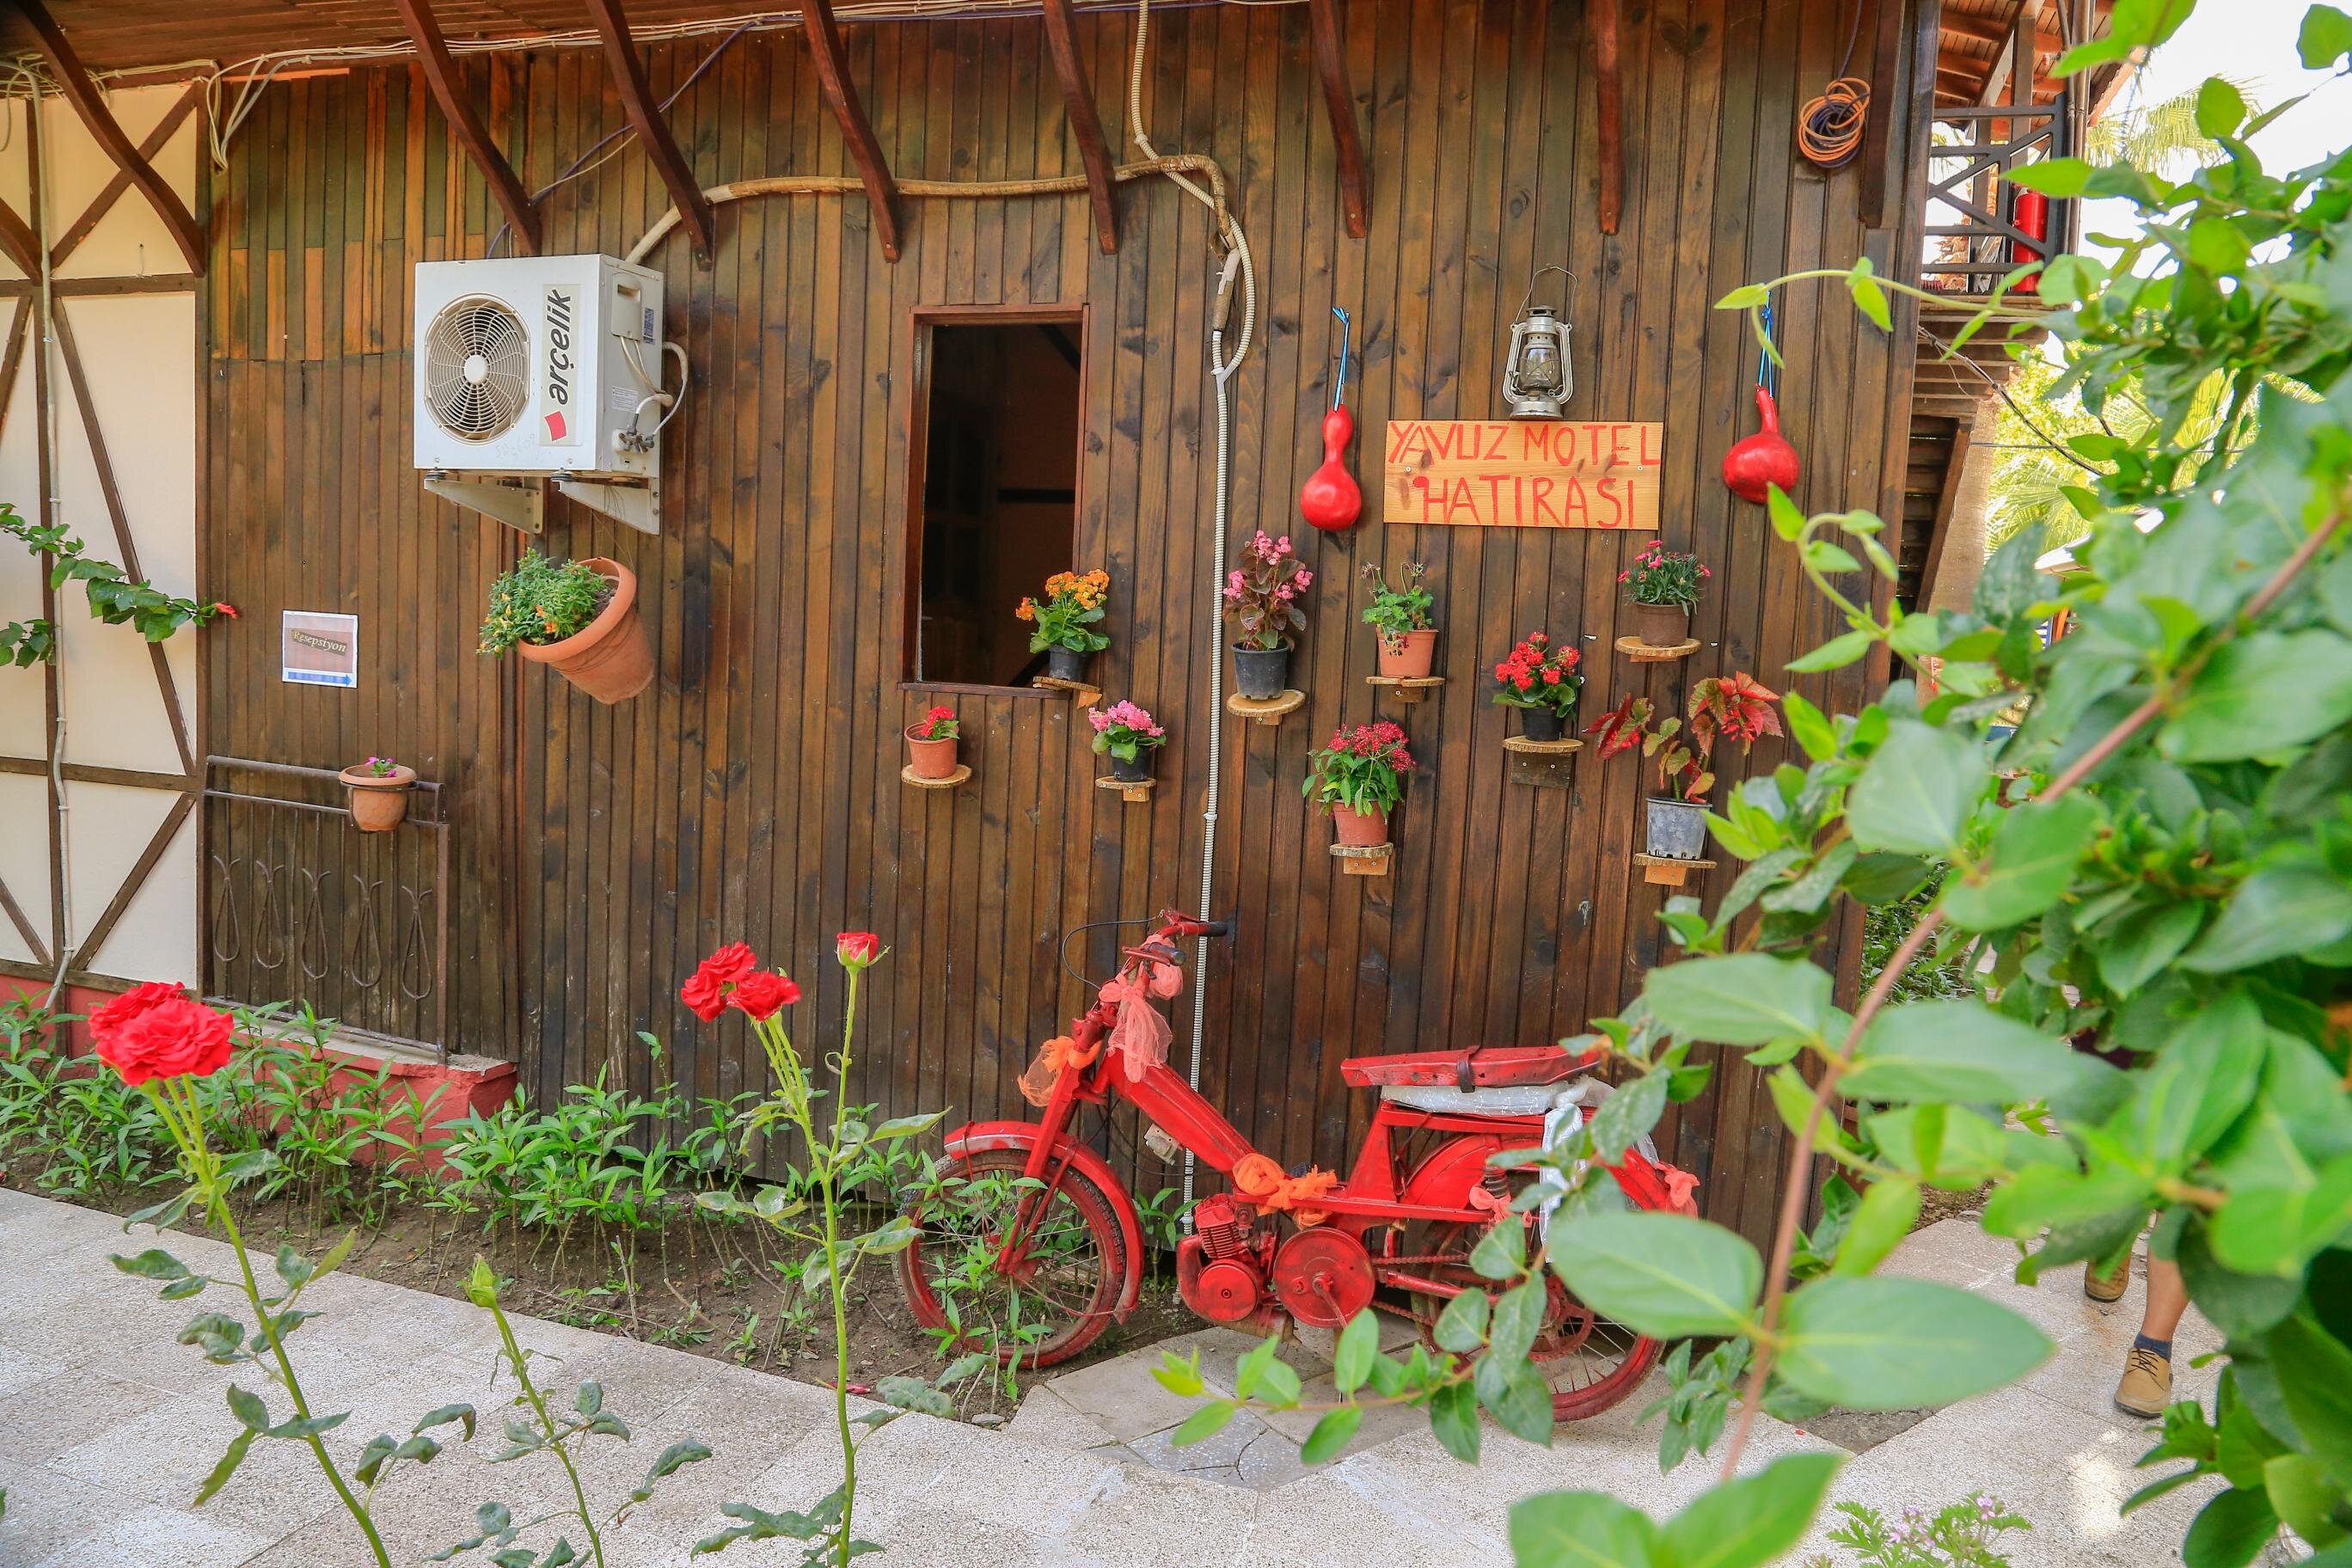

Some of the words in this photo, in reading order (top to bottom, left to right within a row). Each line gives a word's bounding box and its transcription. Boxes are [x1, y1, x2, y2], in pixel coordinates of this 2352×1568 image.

[546, 288, 573, 406] arçelik
[1387, 421, 1510, 465] YAVUZ
[1523, 424, 1662, 466] MOTEL
[1412, 474, 1634, 530] HATIRASI
[293, 631, 347, 652] Resepsiyon
